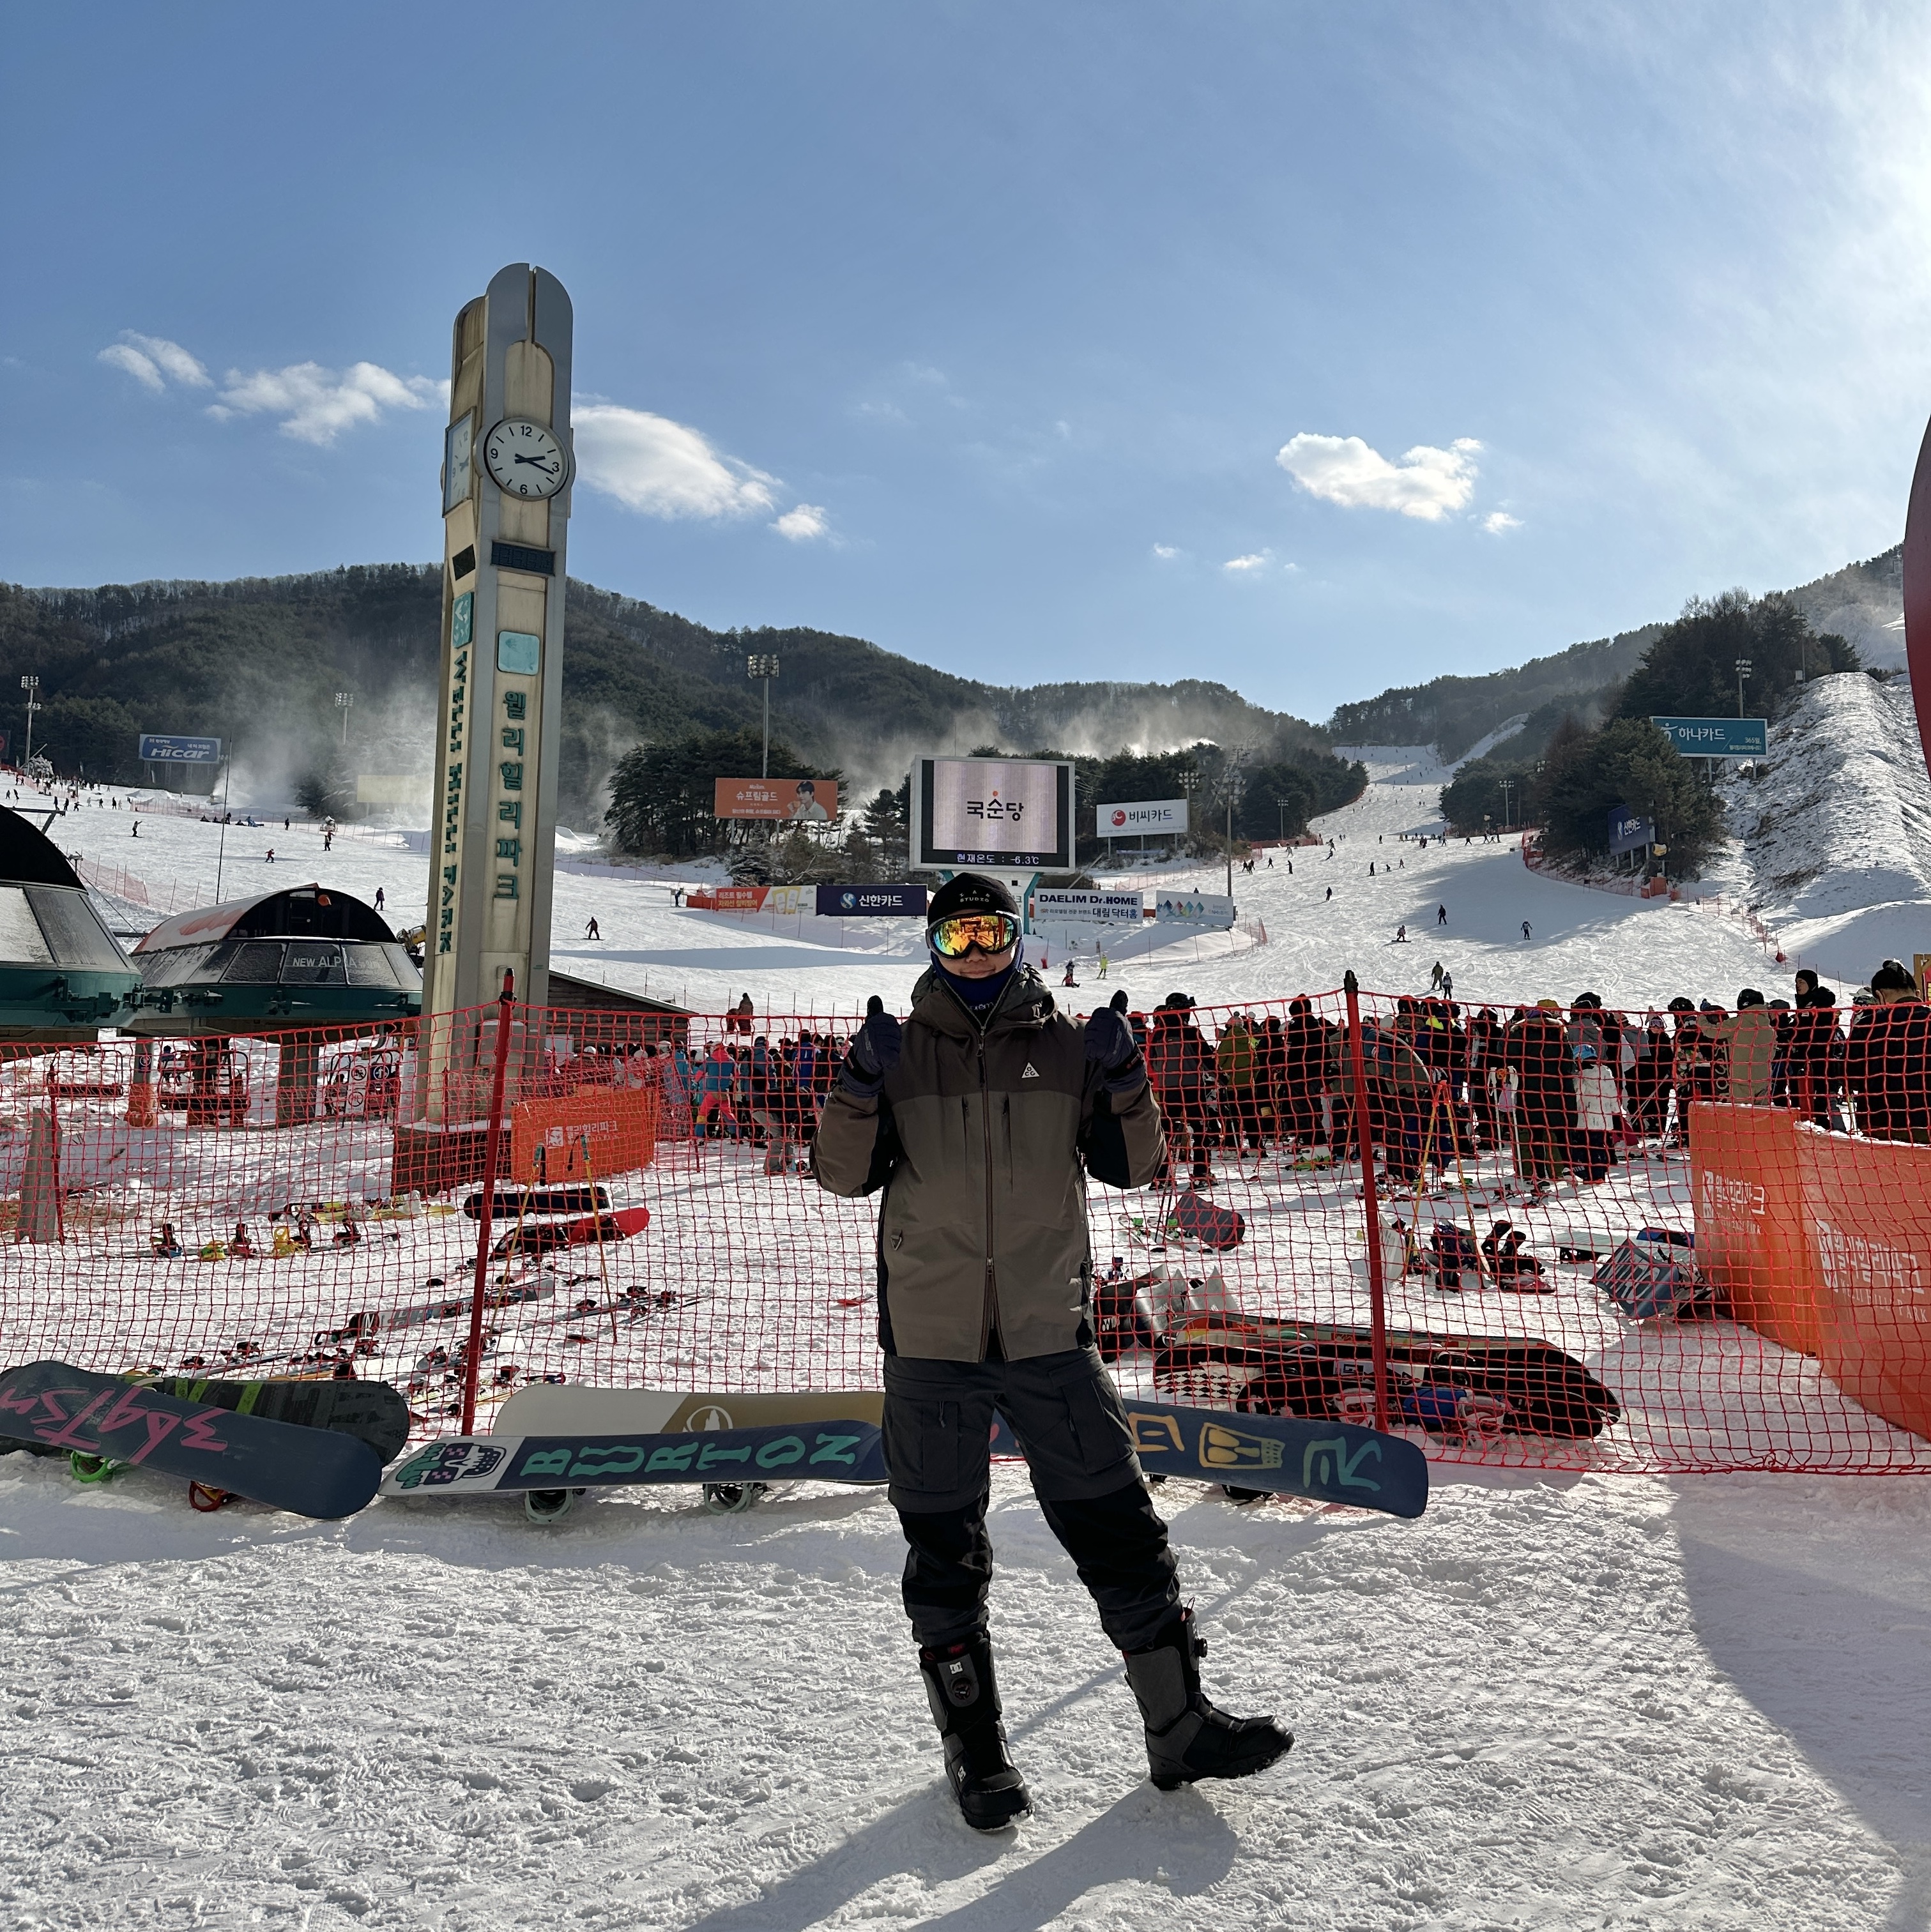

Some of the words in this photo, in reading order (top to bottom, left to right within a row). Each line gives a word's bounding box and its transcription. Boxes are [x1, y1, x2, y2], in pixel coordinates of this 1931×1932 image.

[521, 425, 532, 437] 12
[491, 448, 498, 459] 9
[552, 462, 560, 472] 3
[520, 484, 528, 494] 6
[450, 651, 468, 752] WELLI
[1678, 727, 1726, 742] 하나카드
[151, 748, 210, 759] Hicar
[494, 691, 526, 899] 웰리힐리파크
[736, 791, 778, 801] 슈프림골드
[445, 763, 462, 854] HILLI
[966, 798, 1024, 821] 국순당
[1129, 809, 1173, 823] 비씨카드
[957, 853, 995, 863] 현재온도
[859, 895, 903, 907] 신한카드
[1039, 894, 1086, 904] DAELIM
[1090, 895, 1138, 906] Dr.HOME
[440, 863, 457, 952] PARK
[293, 957, 316, 967] NEW
[318, 956, 358, 968] ALPA
[1897, 1298, 1928, 1323] PARK
[520, 1432, 862, 1478] BURTON
